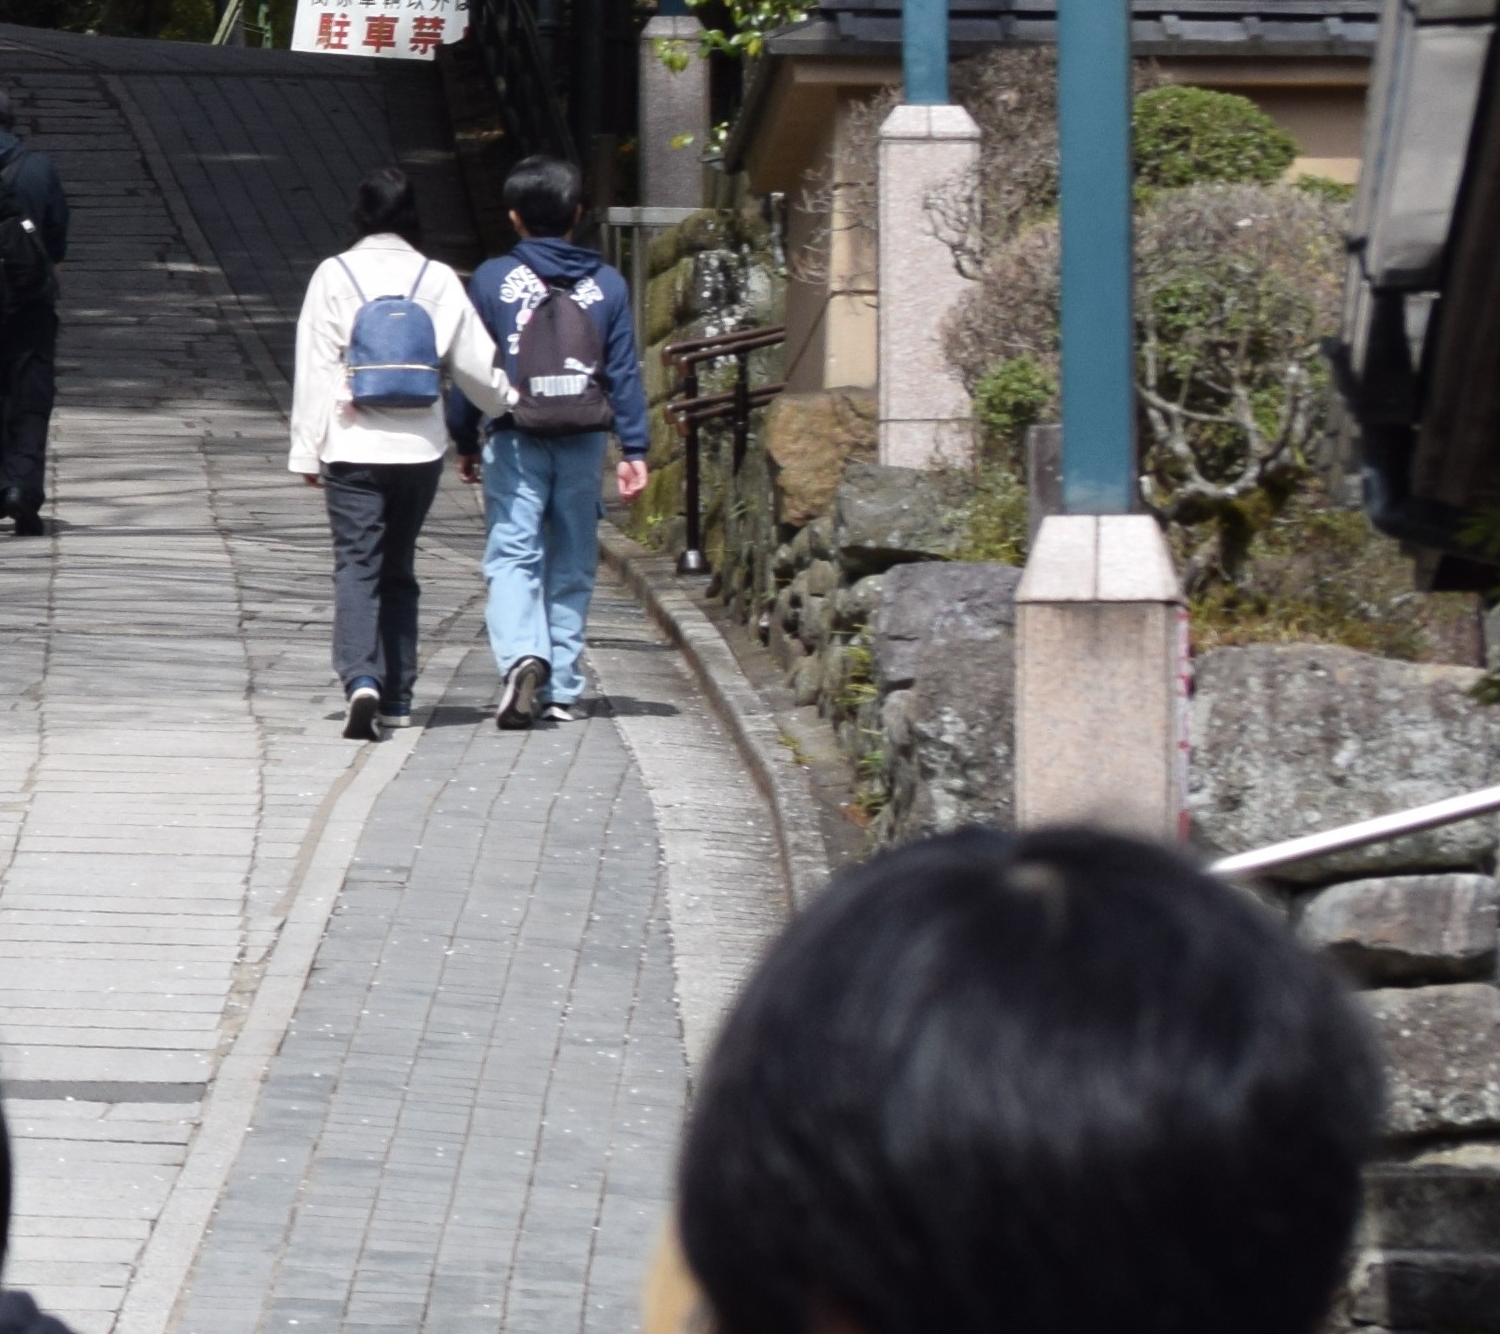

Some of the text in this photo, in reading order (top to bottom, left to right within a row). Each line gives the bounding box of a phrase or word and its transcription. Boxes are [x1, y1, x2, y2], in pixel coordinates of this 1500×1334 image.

[315, 12, 473, 55] 駐車禁
[529, 374, 589, 397] PUMA
